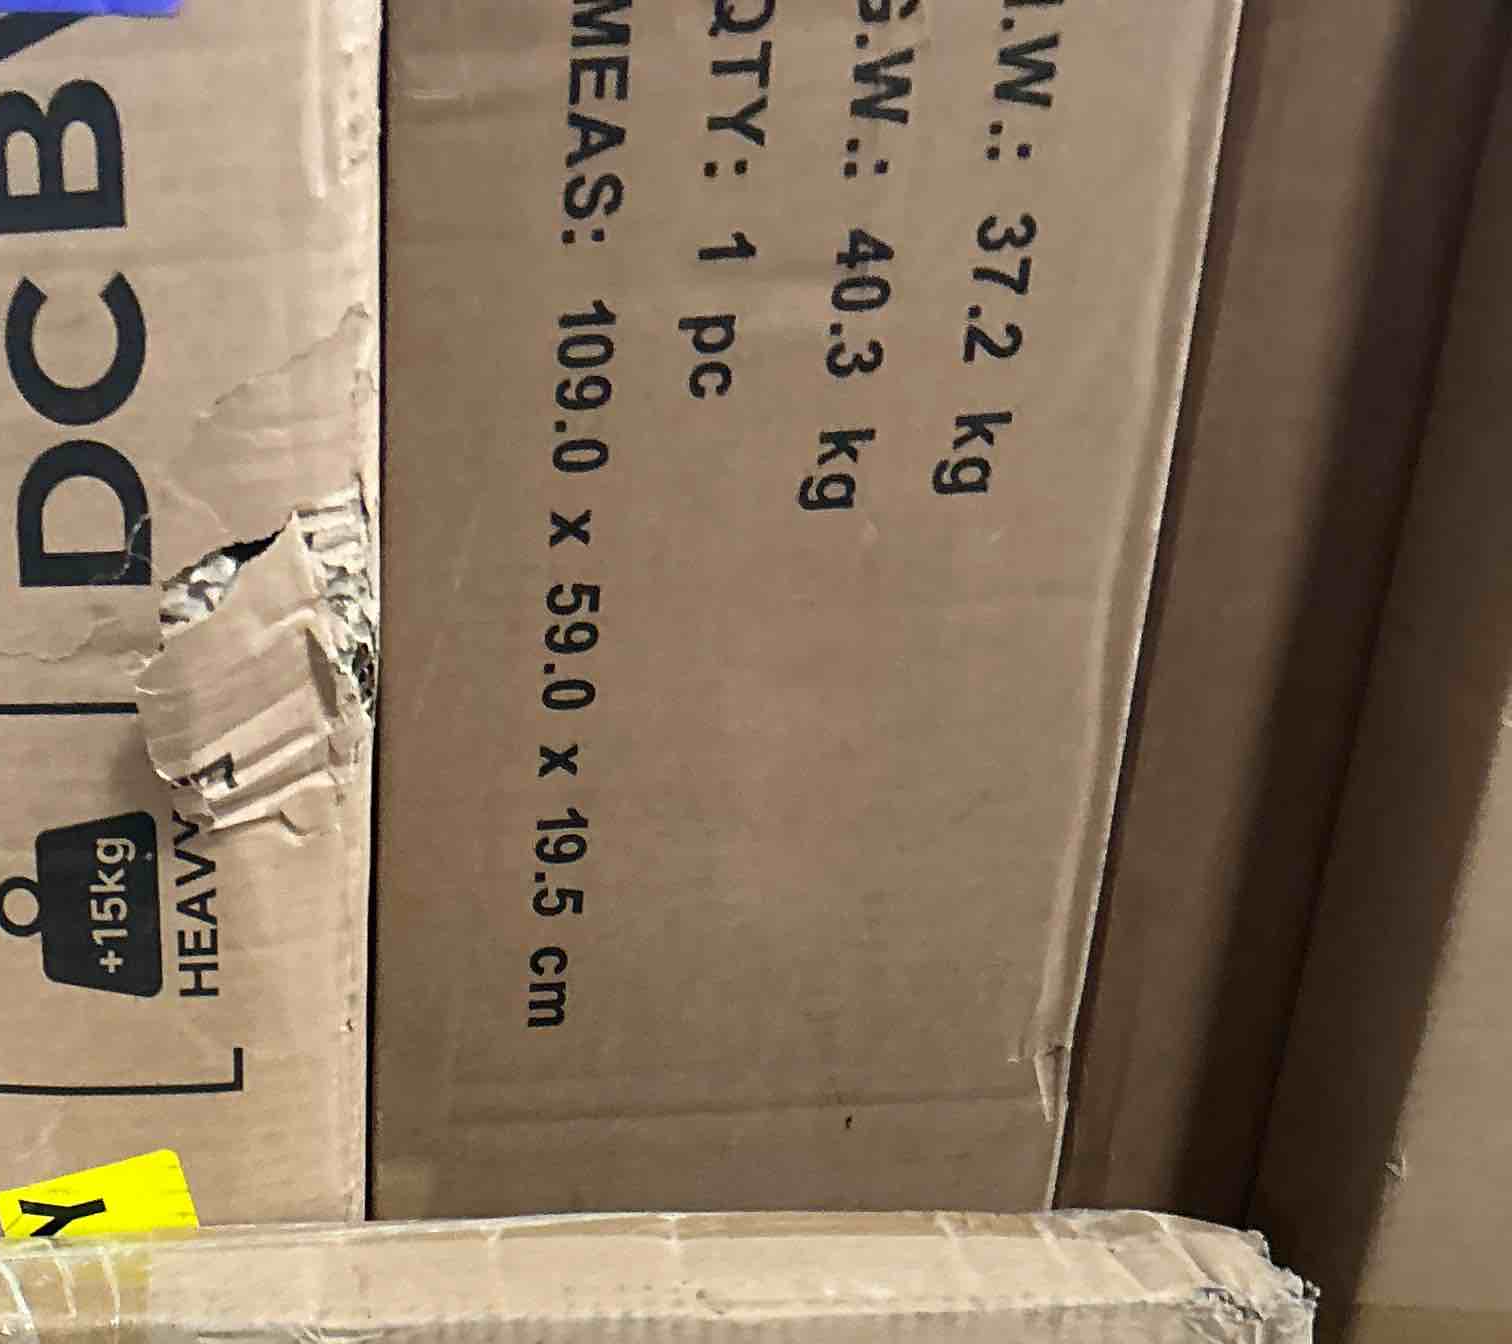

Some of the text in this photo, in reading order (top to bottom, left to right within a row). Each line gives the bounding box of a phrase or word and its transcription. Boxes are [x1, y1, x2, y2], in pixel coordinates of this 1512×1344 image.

[678, 0, 776, 401] QTY: 1 pc
[825, 228, 895, 379] 40.3
[932, 0, 1061, 497] .W.: 37.2 kg
[526, 0, 633, 1028] MEAS: 109.0 x 59.0 x 19.5 cm
[798, 427, 875, 512] kg
[89, 836, 136, 974] +15kg
